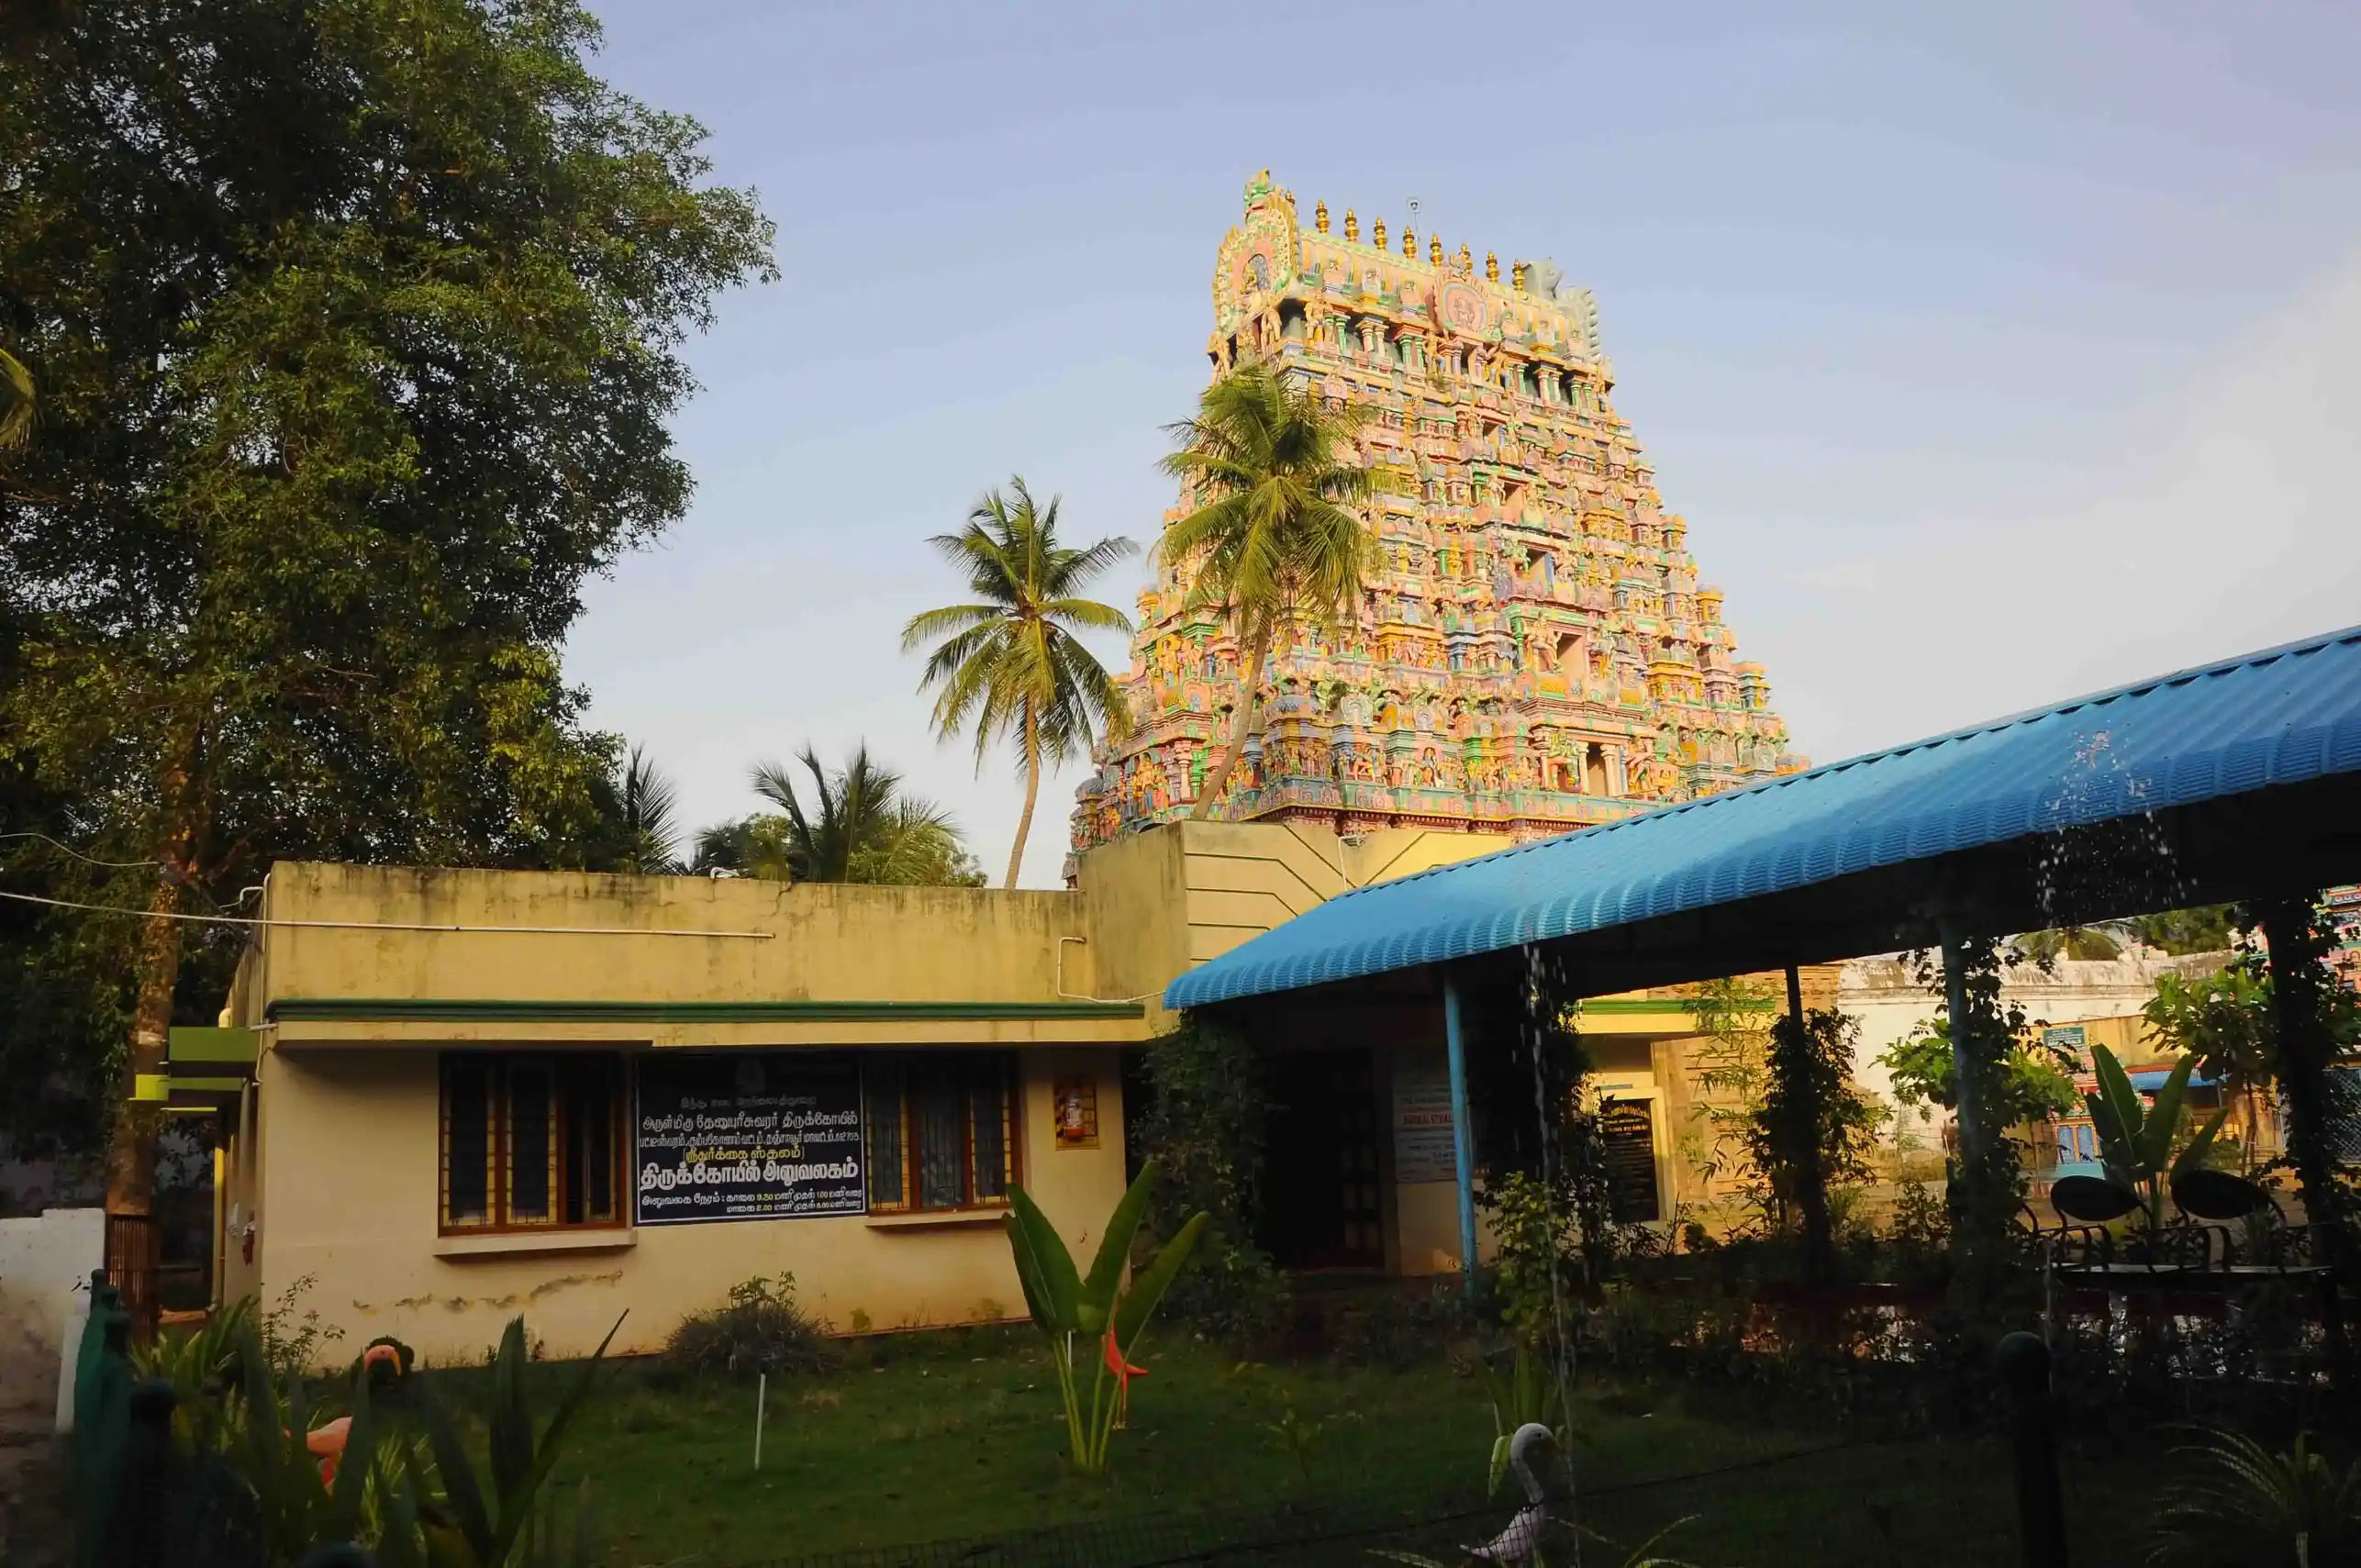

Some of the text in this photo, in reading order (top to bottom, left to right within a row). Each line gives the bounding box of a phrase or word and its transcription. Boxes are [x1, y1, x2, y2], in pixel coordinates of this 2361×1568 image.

[643, 1114, 694, 1132] அருள்மிகு
[782, 1111, 858, 1129] திருக்கோயில்
[640, 1156, 859, 1191] திருக்கோயில் அலுவலகம்
[641, 1195, 692, 1208] அலுவலக
